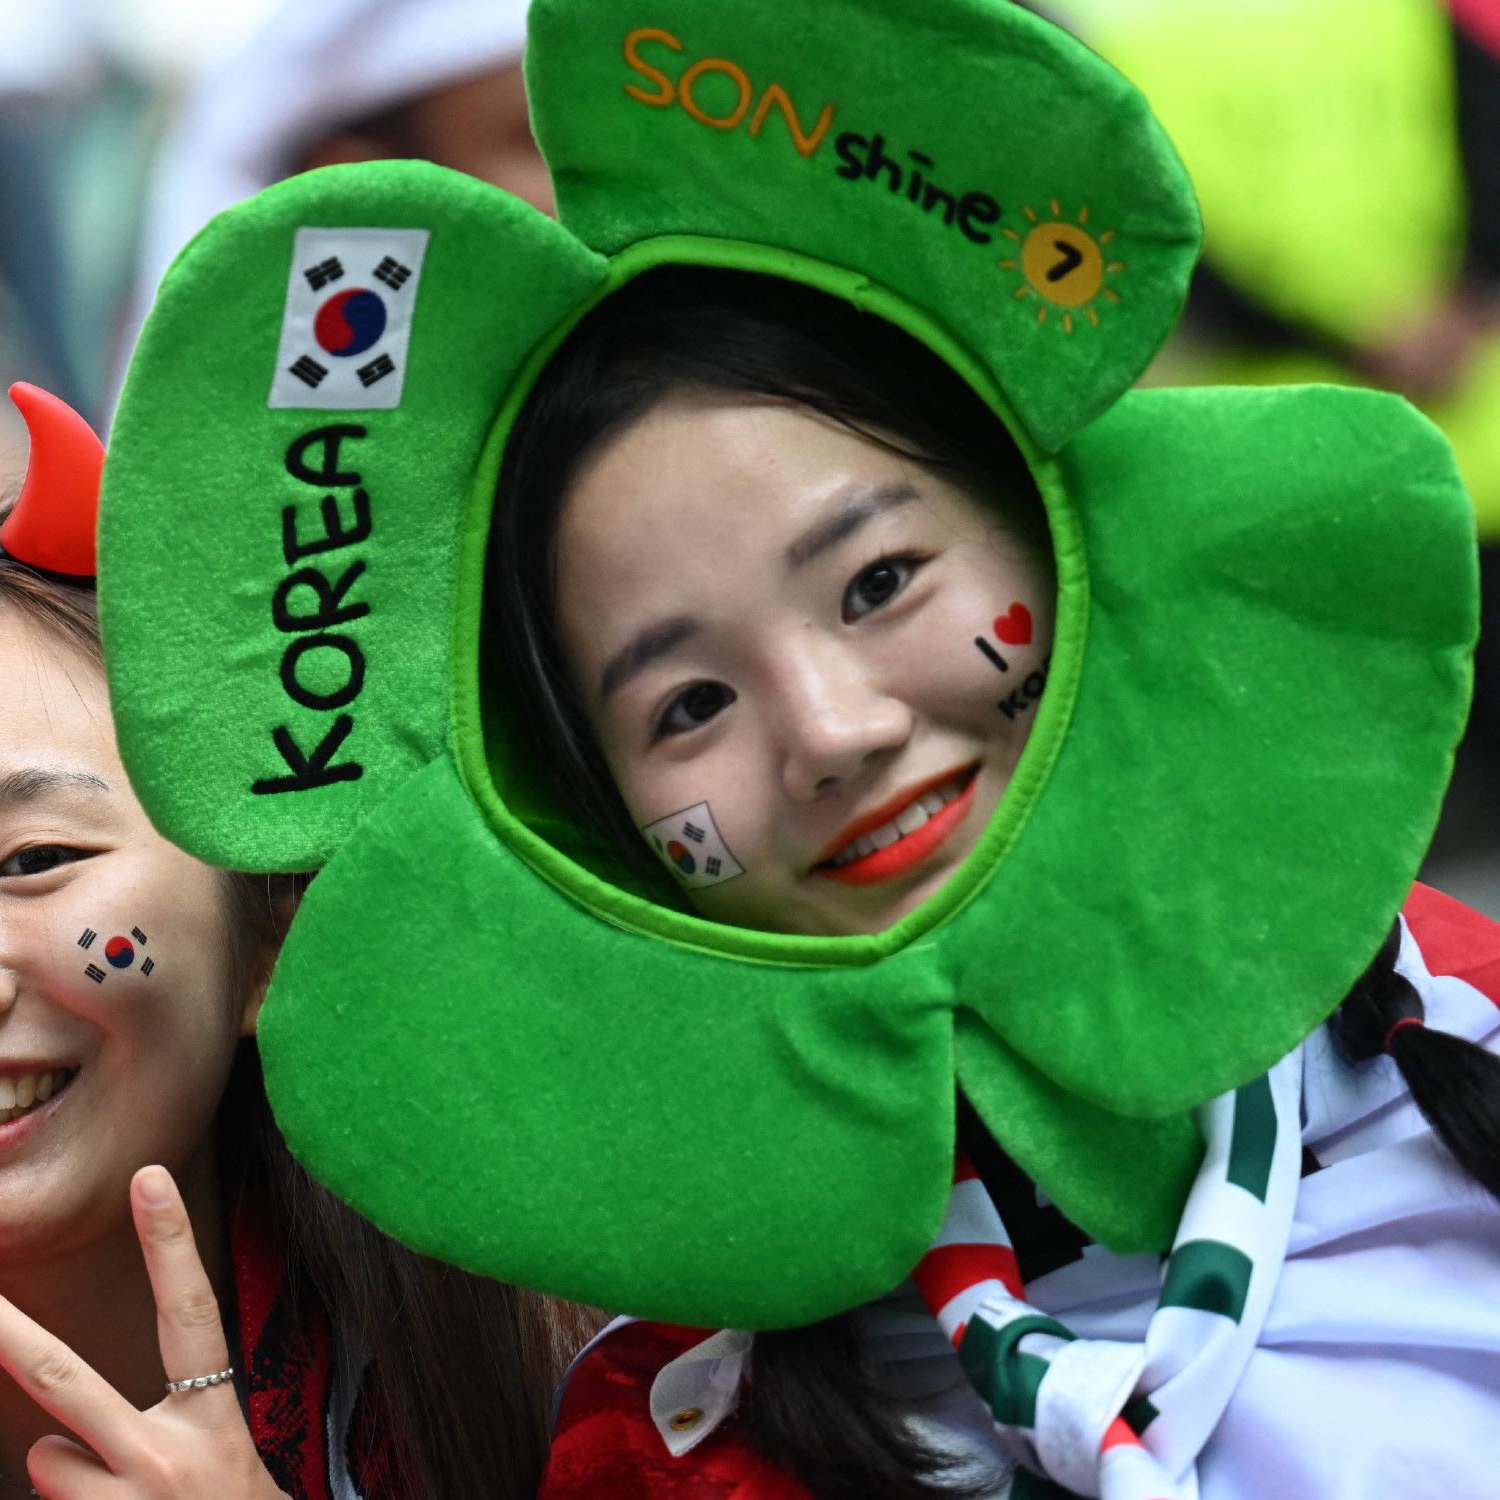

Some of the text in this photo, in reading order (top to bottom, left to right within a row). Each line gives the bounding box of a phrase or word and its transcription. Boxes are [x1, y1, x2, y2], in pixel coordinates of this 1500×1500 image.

[621, 27, 835, 157] SON
[250, 423, 373, 796] KOREA
[974, 635, 1010, 673] I
[998, 652, 1052, 720] KO
